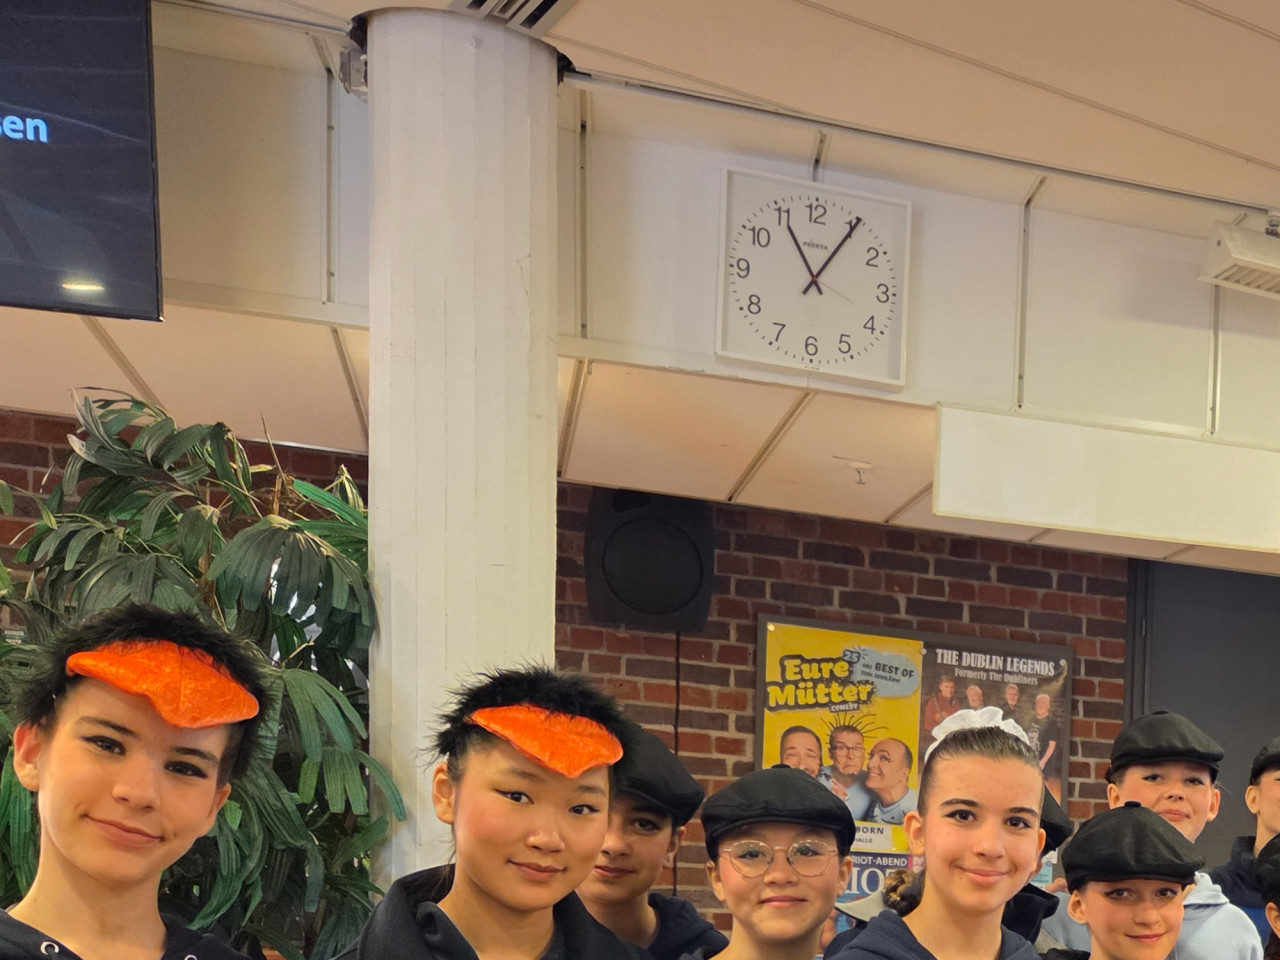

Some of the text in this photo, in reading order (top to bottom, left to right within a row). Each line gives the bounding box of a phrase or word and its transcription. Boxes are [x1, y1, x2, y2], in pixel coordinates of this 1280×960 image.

[0, 115, 48, 143] en
[774, 206, 791, 227] 11
[805, 203, 827, 225] 12
[749, 226, 771, 248] 10
[865, 247, 879, 268] 2
[736, 258, 750, 279] 9
[876, 283, 890, 303] 3
[747, 294, 761, 314] 8
[772, 322, 786, 342] 7
[863, 315, 877, 335] 4
[805, 336, 818, 356] 6
[838, 334, 851, 353] 5
[844, 650, 860, 663] 25
[936, 649, 1055, 677] THE DUBLIN LEGENDS
[784, 659, 849, 681] Eure
[875, 662, 899, 675] BEST
[901, 669, 914, 678] OF
[954, 668, 1038, 686] Formerly The Dubliners
[767, 682, 872, 707] Mütter
[831, 703, 858, 711] COMEDY
[855, 826, 884, 835] BORN
